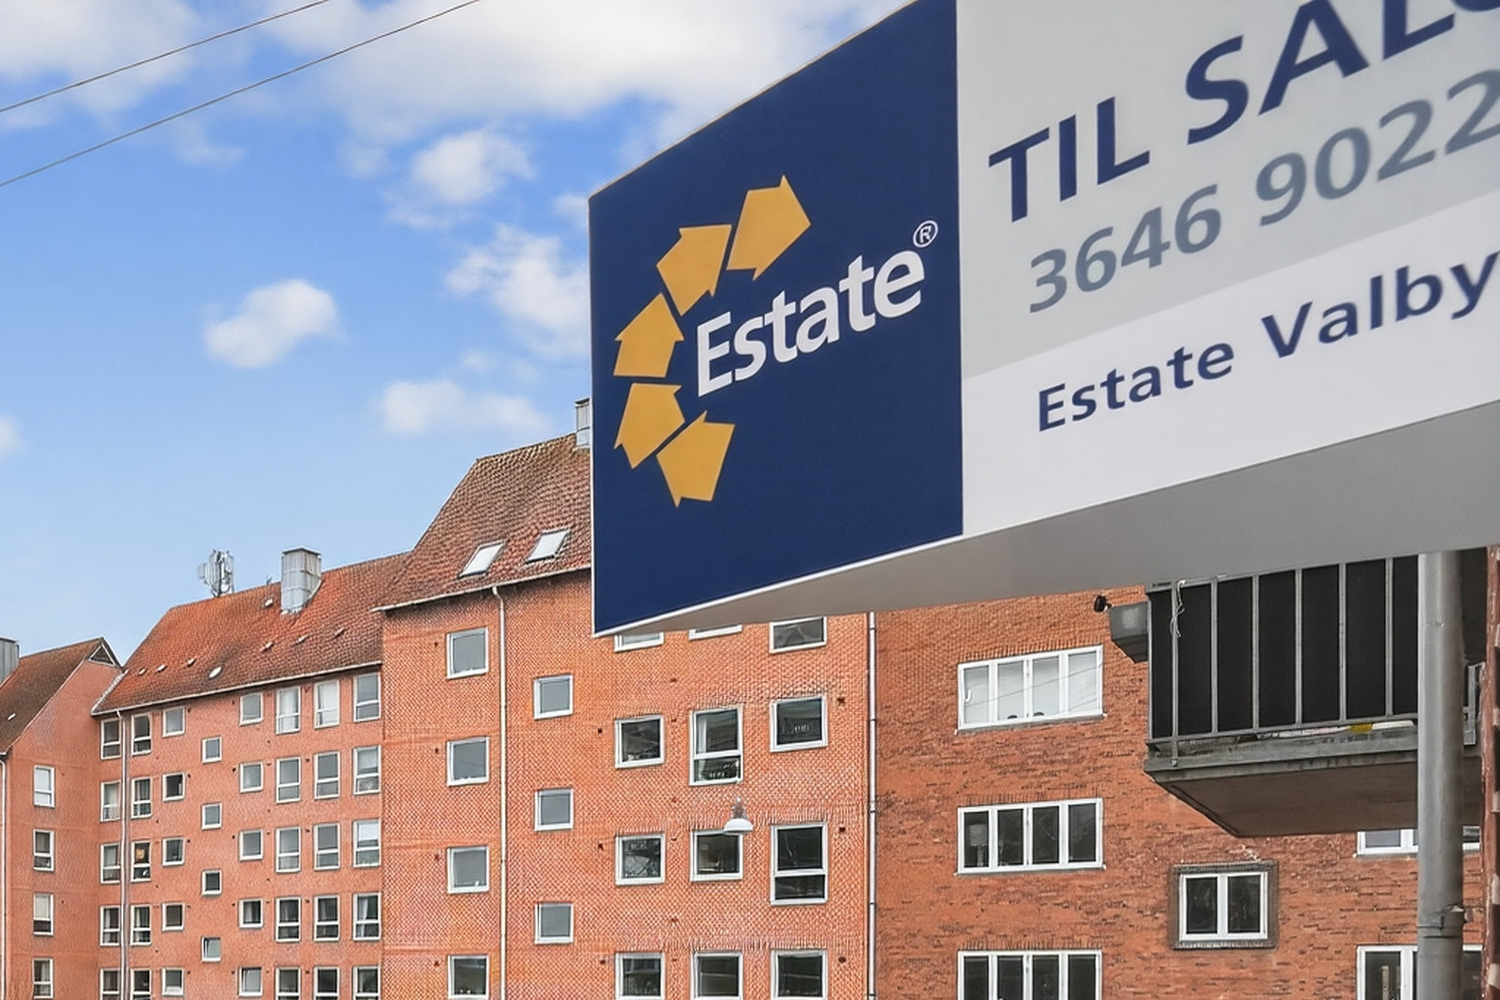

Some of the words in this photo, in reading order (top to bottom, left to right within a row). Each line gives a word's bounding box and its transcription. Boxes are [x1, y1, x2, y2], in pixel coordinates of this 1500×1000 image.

[988, 96, 1150, 223] TIL
[1186, 0, 1500, 146] SAL
[1029, 183, 1222, 314] 3646
[1255, 69, 1500, 227] 9022
[1038, 341, 1235, 432] Estate
[1260, 250, 1500, 359] Valby
